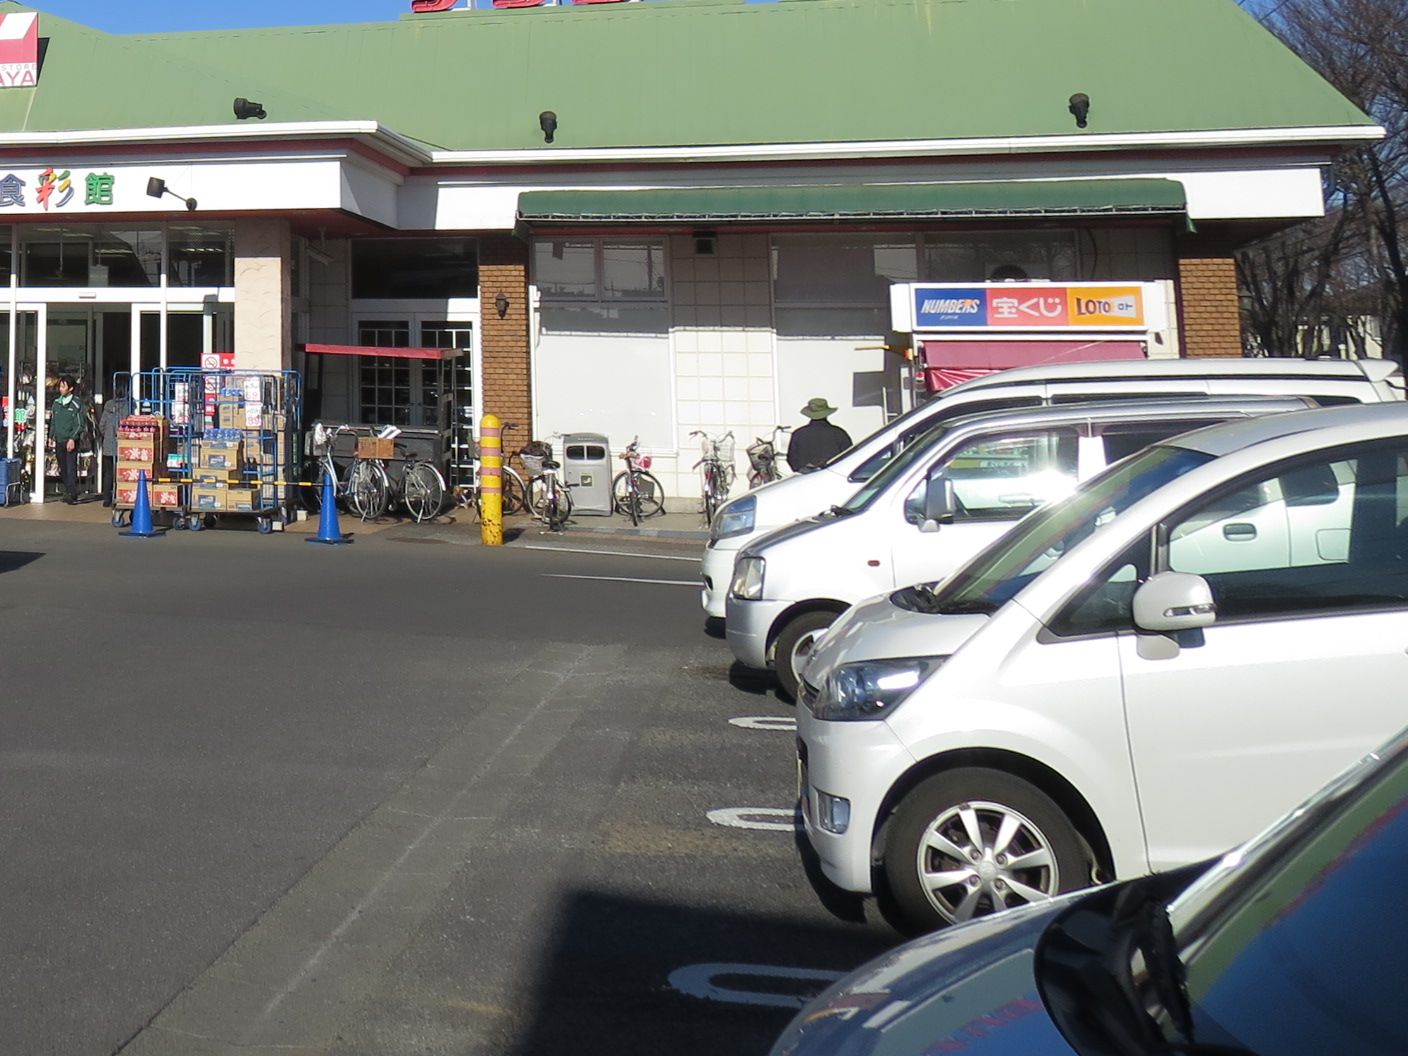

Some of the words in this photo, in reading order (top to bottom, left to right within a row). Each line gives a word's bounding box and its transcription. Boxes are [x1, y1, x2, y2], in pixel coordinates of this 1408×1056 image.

[921, 298, 981, 315] NUMBERS
[992, 297, 1063, 318] 宝くじ
[1076, 297, 1111, 317] LOTO
